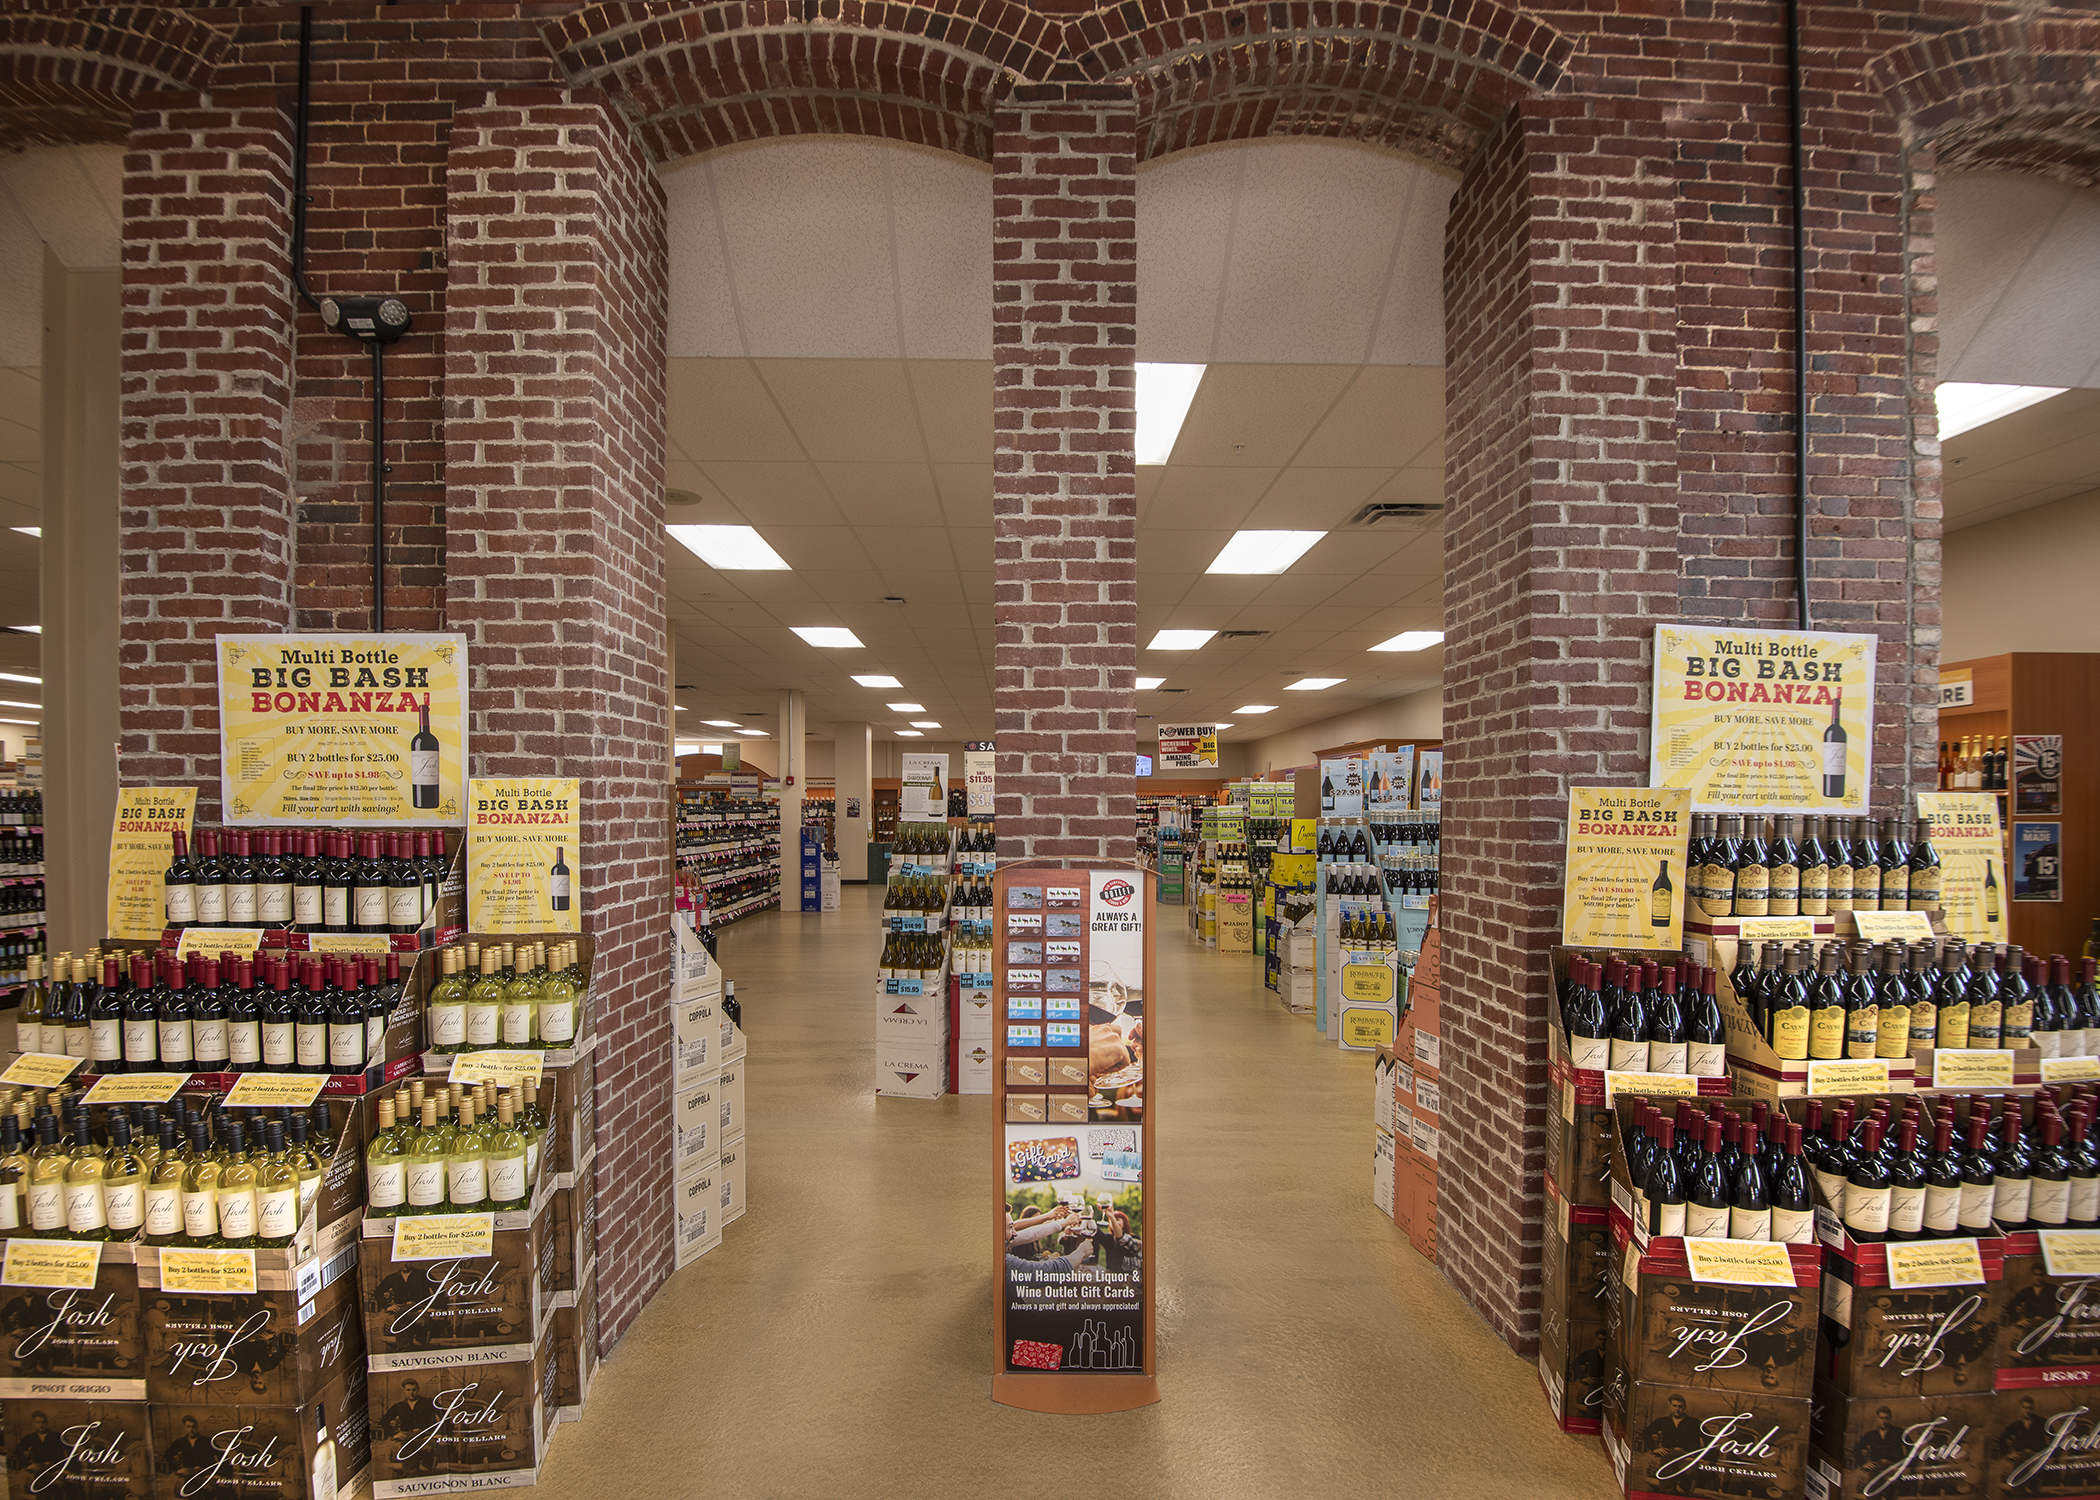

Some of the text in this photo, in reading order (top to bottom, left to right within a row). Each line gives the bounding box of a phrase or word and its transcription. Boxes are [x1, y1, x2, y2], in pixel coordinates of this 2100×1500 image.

[1715, 641, 1818, 658] Multi Bottle
[281, 650, 398, 664] Multi Bottle
[1686, 657, 1842, 682] BIG BASH
[252, 668, 428, 688] BIG BASH
[1684, 680, 1842, 705] BONANZA!
[252, 692, 430, 712] BONANZA!
[285, 726, 399, 735] BUY MORE, SAVE MORE
[1197, 727, 1215, 735] BUY!
[980, 742, 995, 750] SA
[287, 753, 399, 763] BUY 2 bottles for $25.00
[308, 771, 330, 779] SAVE
[332, 772, 343, 780] up
[355, 771, 379, 779] $4.98
[282, 804, 399, 814] Fill your cart with savings!
[478, 800, 568, 810] BIG BASH
[1599, 799, 1660, 807] Multi Bottle
[122, 809, 185, 818] BIG BASH
[477, 813, 568, 824] BONANZA!
[1580, 810, 1677, 822] BIG BASH
[1957, 815, 1991, 824] BASH
[119, 822, 184, 832] BONANZA!
[1578, 823, 1677, 836] BONANZA!
[1930, 827, 1993, 837] BONANZA!
[1707, 865, 1719, 875] 50
[1104, 886, 1130, 899] OUTLET
[1096, 913, 1137, 921] ALWAYS A
[1092, 923, 1141, 931] GREAT GIFT!
[1350, 971, 1385, 979] ROMBAUER
[689, 1007, 711, 1022] COPPOLA
[394, 1058, 414, 1071] CABERNET
[394, 1065, 415, 1077] SAUVIGNON
[898, 1062, 929, 1070] CREMA
[1815, 1076, 1825, 1084] Buy
[1832, 1075, 1849, 1083] bottles
[688, 1093, 710, 1110] COPPOLA
[1015, 1144, 1043, 1167] Gift
[1036, 1147, 1071, 1167] Card
[689, 1180, 711, 1198] COPPOLA
[404, 1234, 416, 1242] Buy
[460, 1230, 485, 1238] $25.00
[1011, 1270, 1139, 1284] New Hampshire Liquor &
[390, 1256, 500, 1334] Josh
[1016, 1286, 1134, 1297] Wine Outlet Gift Cards
[1011, 1303, 1032, 1311] Always
[1039, 1303, 1054, 1311] great
[1056, 1303, 1067, 1311] gift
[1081, 1303, 1101, 1311] always
[1103, 1303, 1139, 1311] appreciated!
[15, 1289, 115, 1358] Josh
[1668, 1301, 1792, 1371] Josh
[1880, 1295, 1981, 1377] Josh
[169, 1310, 270, 1386] Josh
[392, 1352, 507, 1368] SAUVIGNON BLANC
[2042, 1370, 2091, 1382] LEGACY
[31, 1384, 110, 1393] PINOT GRIGIO
[397, 1383, 503, 1460] Josh
[1656, 1413, 1779, 1480] Josh
[30, 1421, 125, 1493] Josh
[180, 1426, 278, 1497] Josh
[1863, 1416, 1969, 1497] Josh
[1699, 1464, 1777, 1479] JOSH CELLARS
[398, 1476, 511, 1494] SAUVIGNON BLANC
